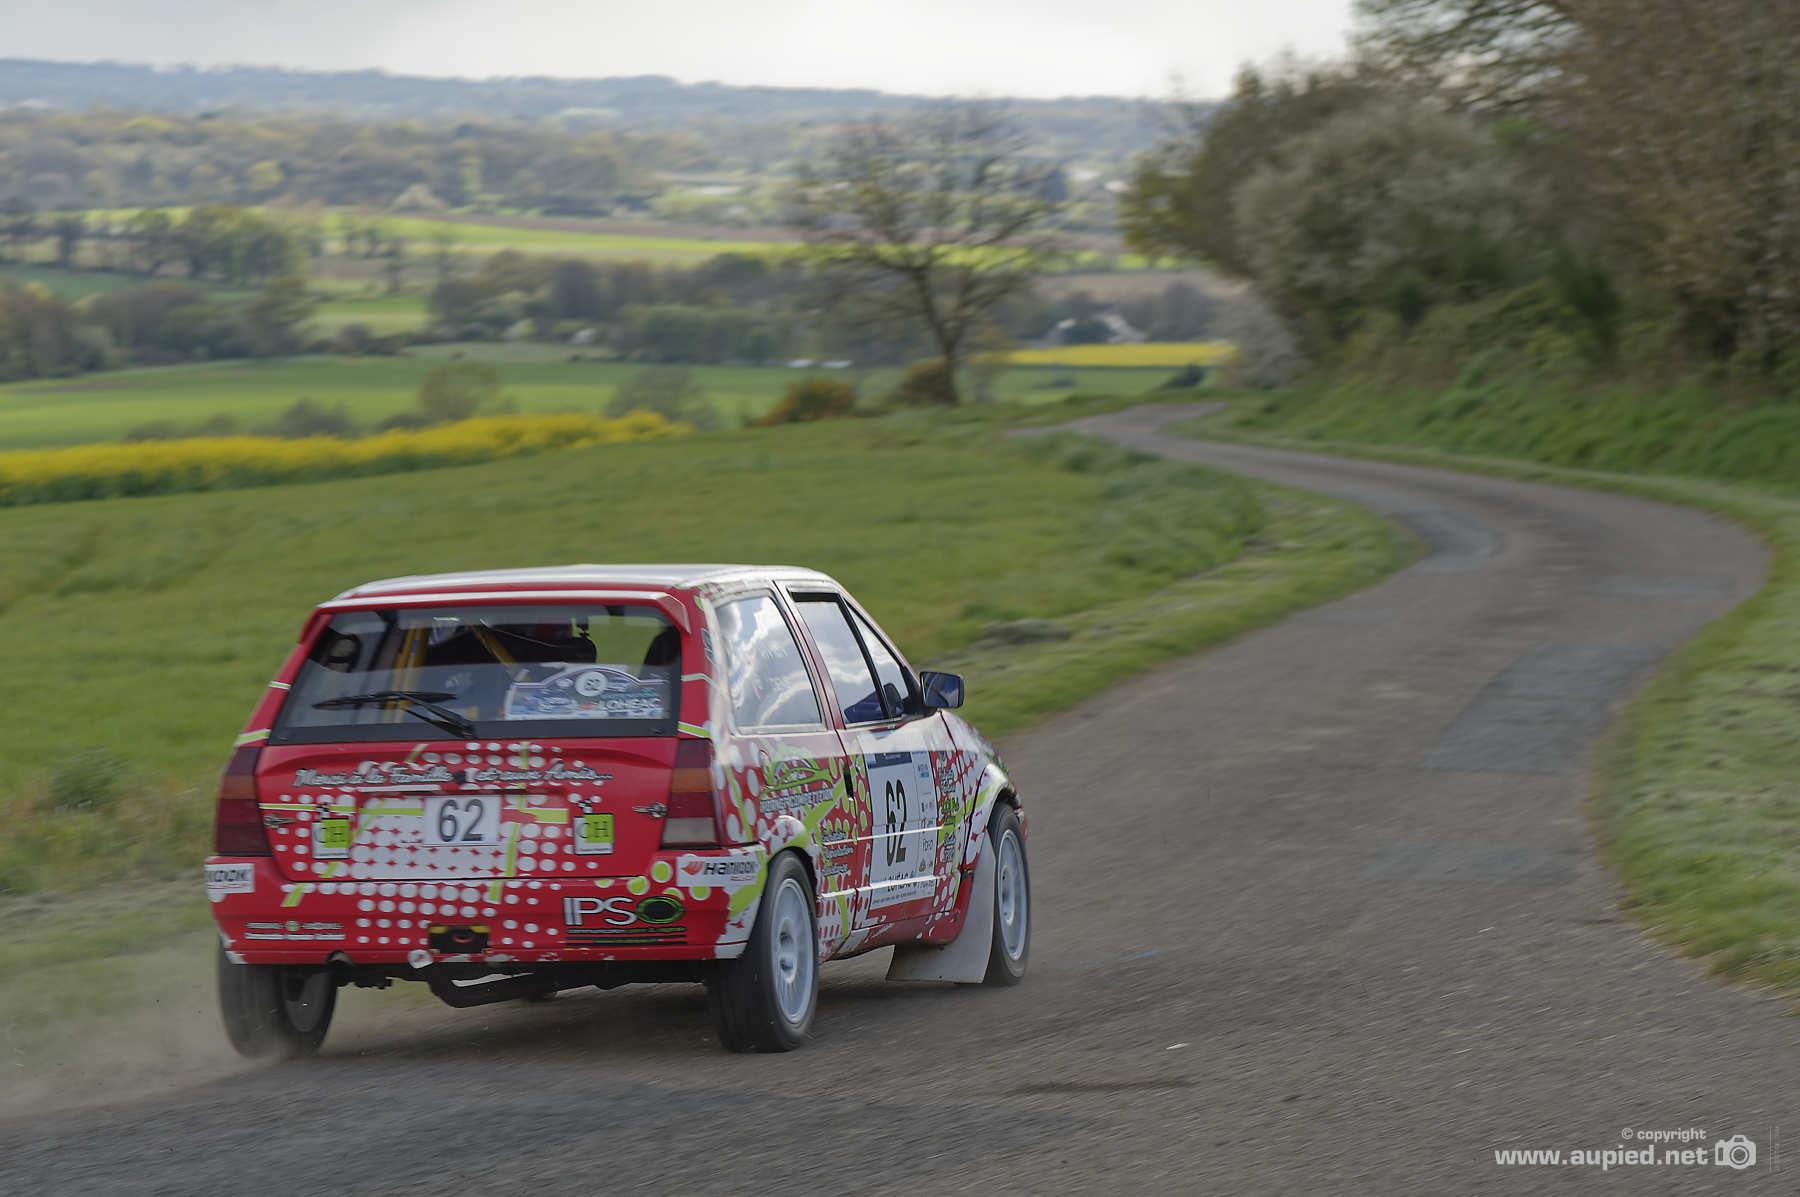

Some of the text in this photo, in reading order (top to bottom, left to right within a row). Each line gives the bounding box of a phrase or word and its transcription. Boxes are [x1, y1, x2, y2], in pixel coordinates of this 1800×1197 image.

[389, 765, 453, 784] Famille
[439, 799, 485, 842] 62
[885, 779, 907, 866] 62
